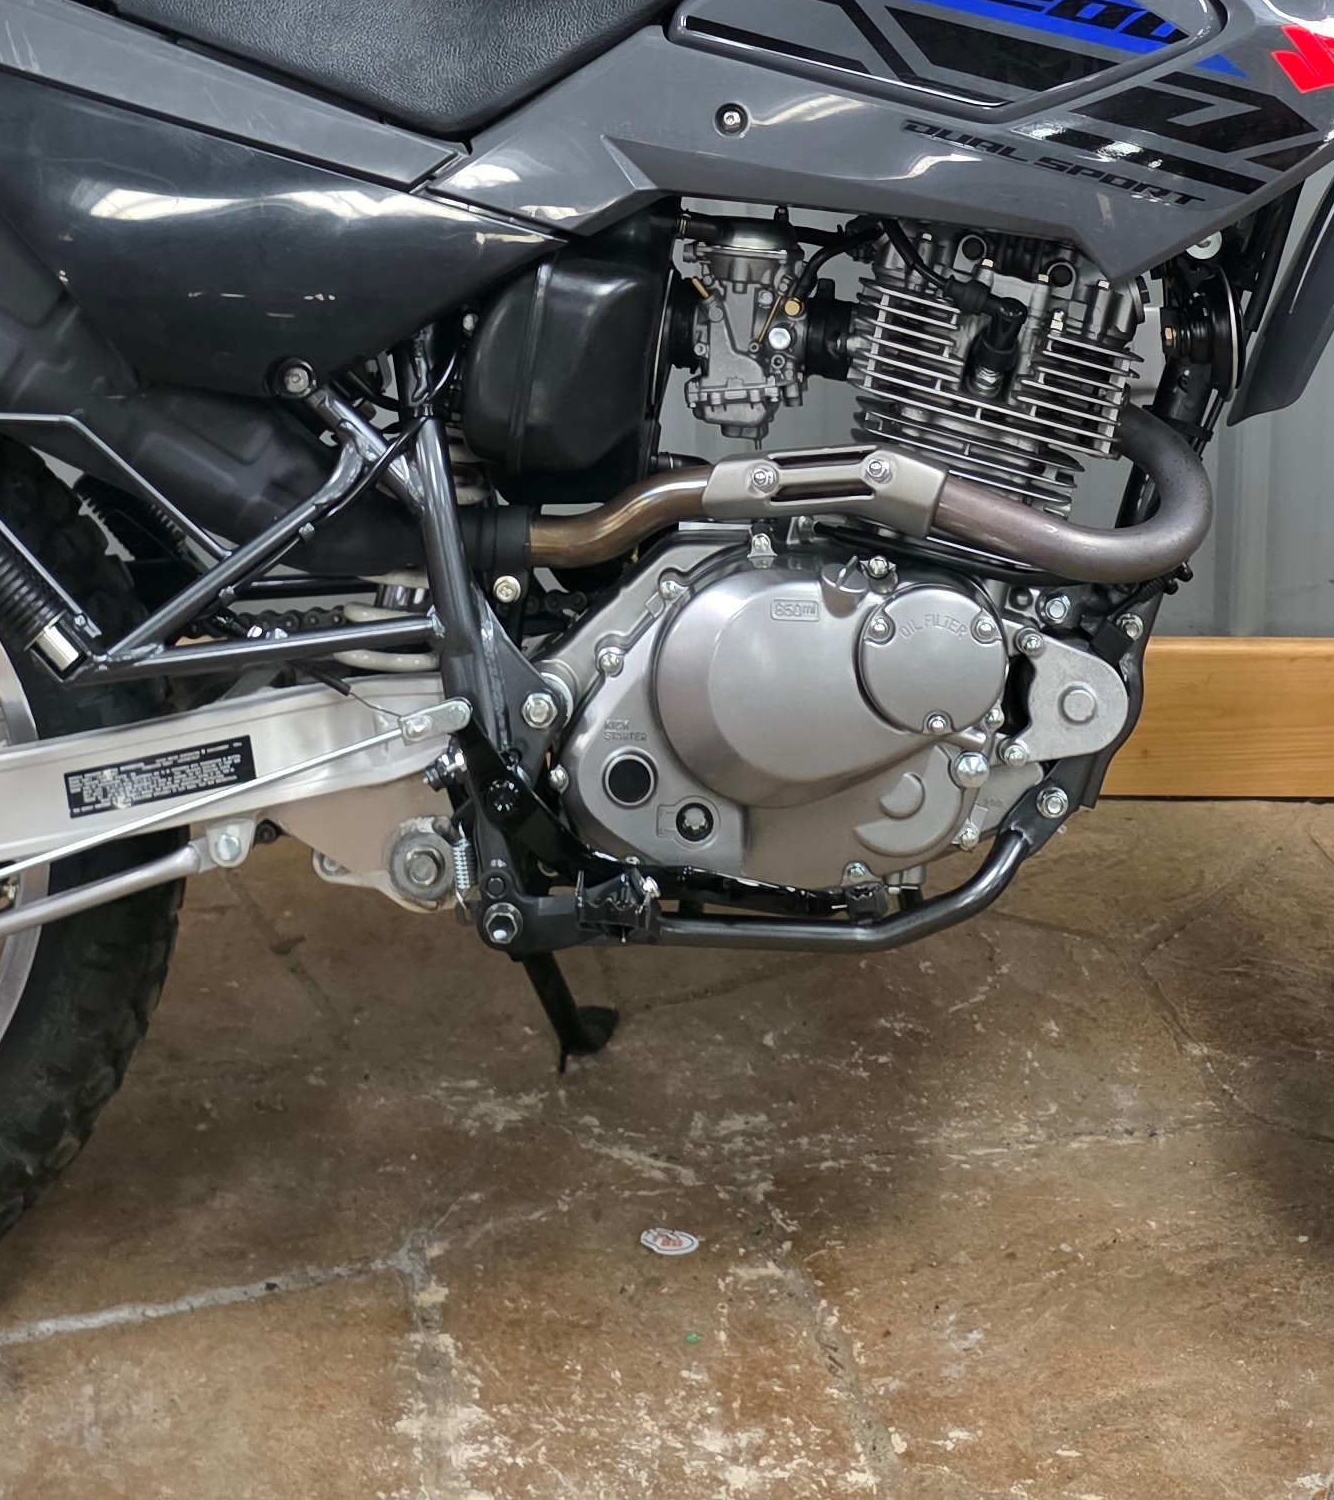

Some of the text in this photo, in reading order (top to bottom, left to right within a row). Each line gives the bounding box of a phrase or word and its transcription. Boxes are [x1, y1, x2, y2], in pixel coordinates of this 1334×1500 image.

[903, 118, 1206, 206] DUAL SPORT
[923, 612, 969, 640] FILTER
